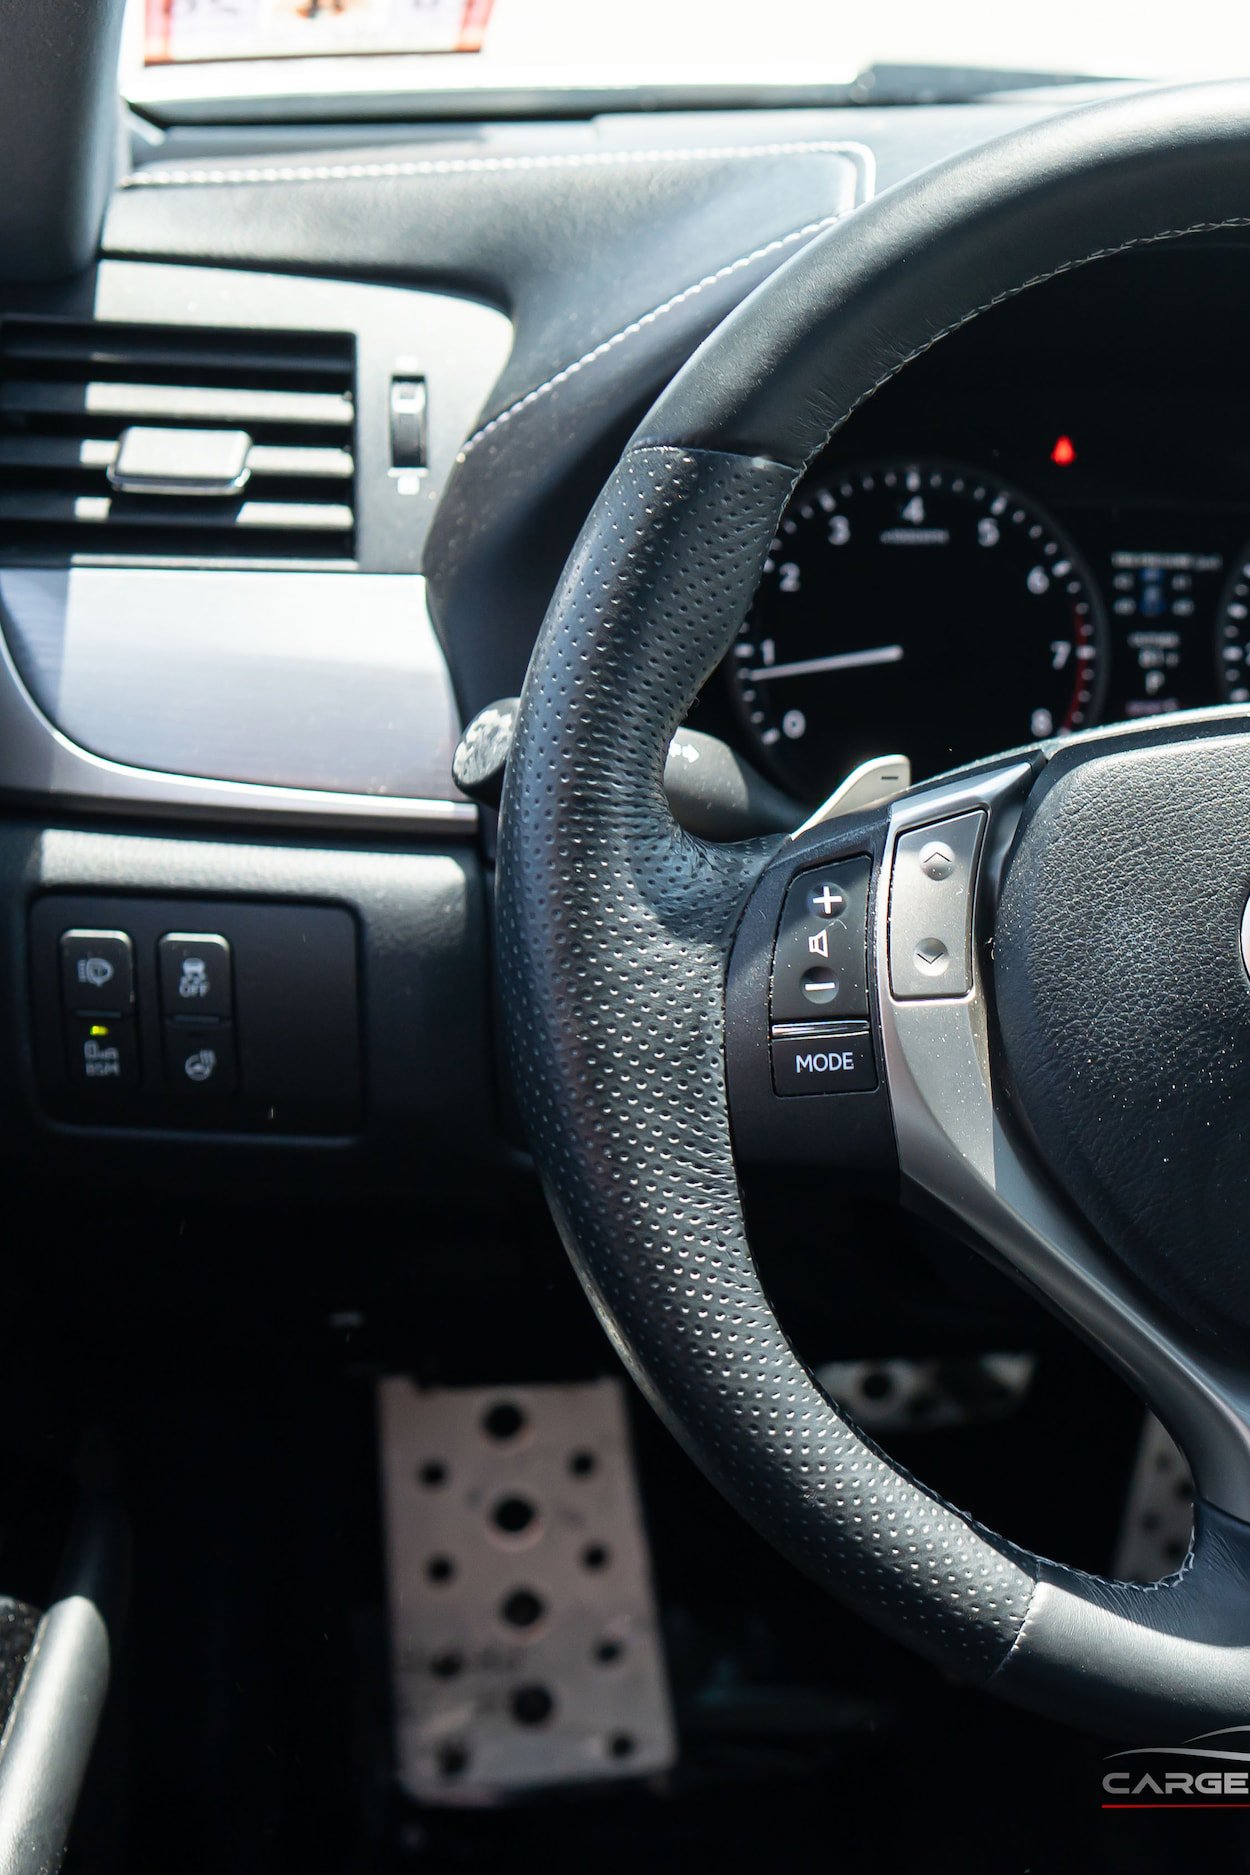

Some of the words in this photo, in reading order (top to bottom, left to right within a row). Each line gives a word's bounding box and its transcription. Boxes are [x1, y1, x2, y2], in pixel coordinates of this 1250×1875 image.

[903, 495, 924, 524] 4
[828, 515, 851, 546] 3
[978, 517, 999, 546] 5
[779, 562, 800, 592] 2
[1027, 566, 1049, 595] 6
[760, 638, 775, 666] 1
[1051, 639, 1071, 669] 7
[782, 709, 806, 740] 0
[1030, 708, 1053, 738] 8
[796, 1052, 855, 1073] MODE
